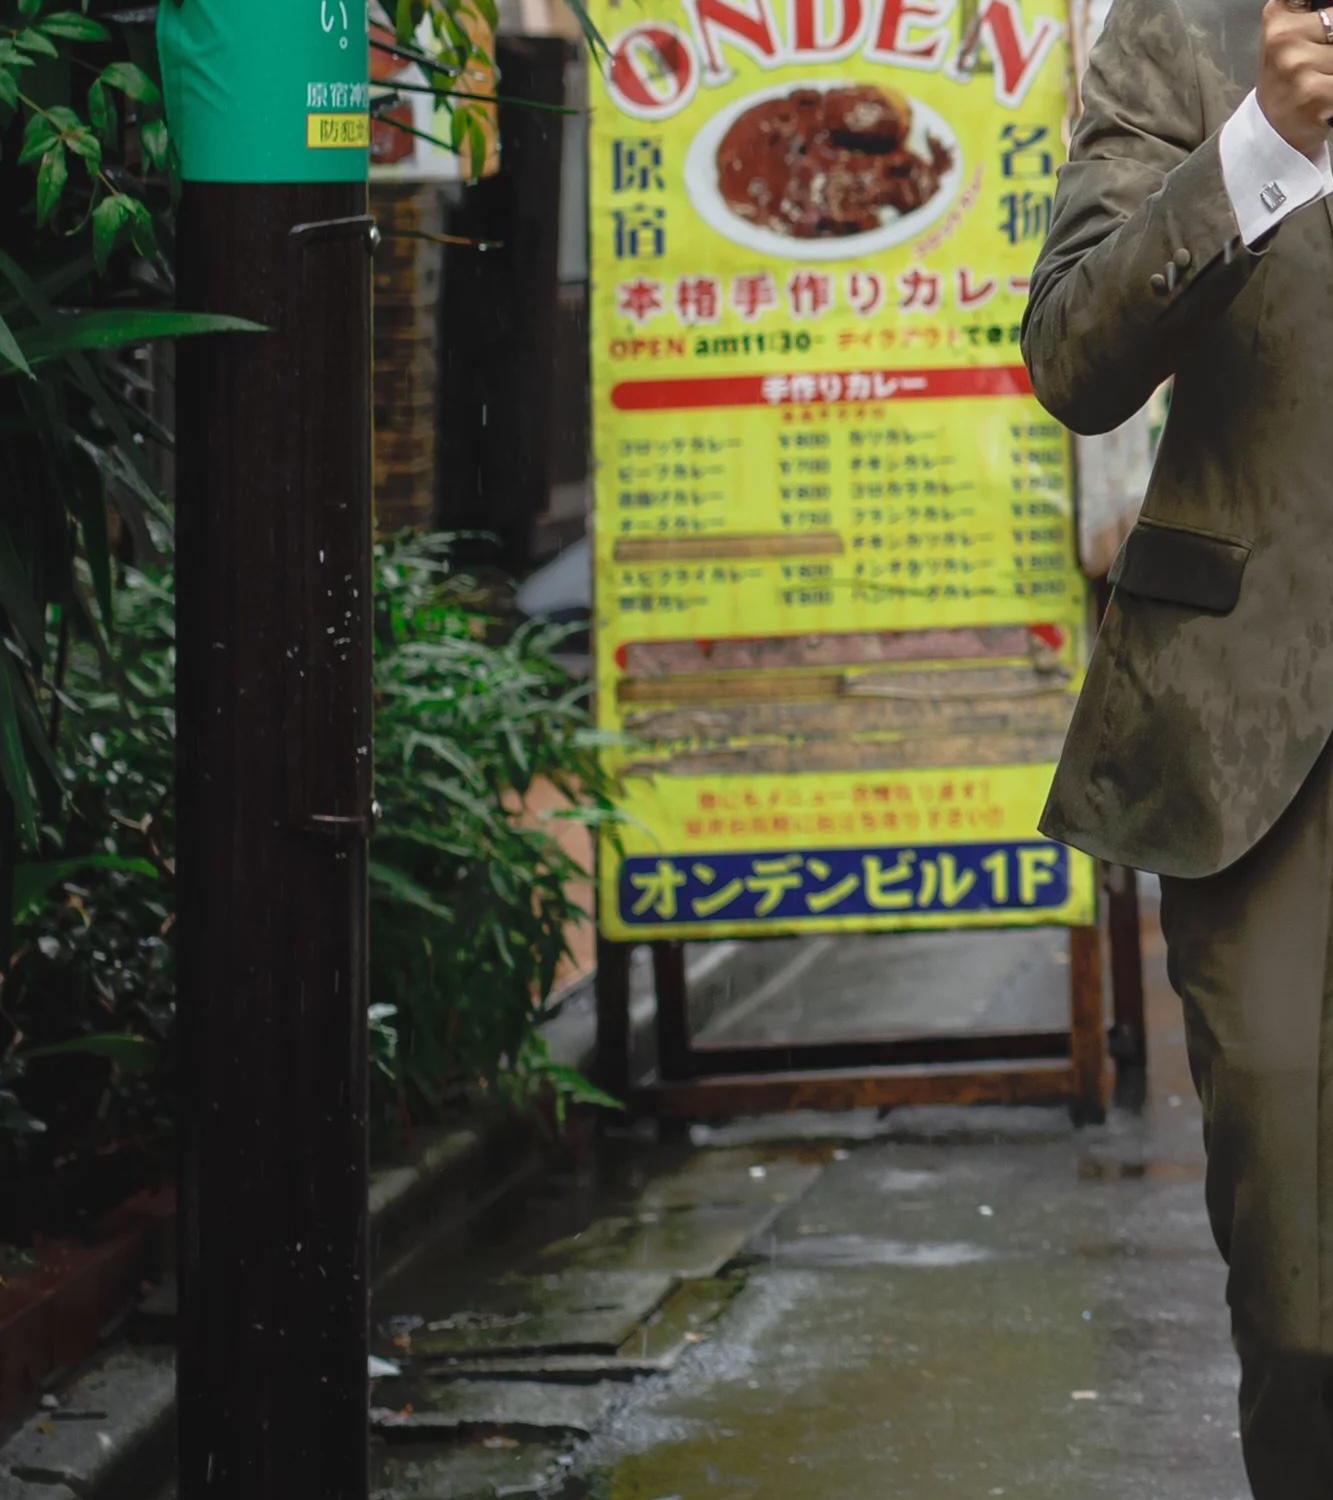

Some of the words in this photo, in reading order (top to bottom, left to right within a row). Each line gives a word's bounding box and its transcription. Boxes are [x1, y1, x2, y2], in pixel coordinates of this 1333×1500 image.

[611, 136, 667, 260] 原宿
[760, 368, 929, 406] 手作りカレー
[630, 843, 1060, 918] オンデンビル1F
